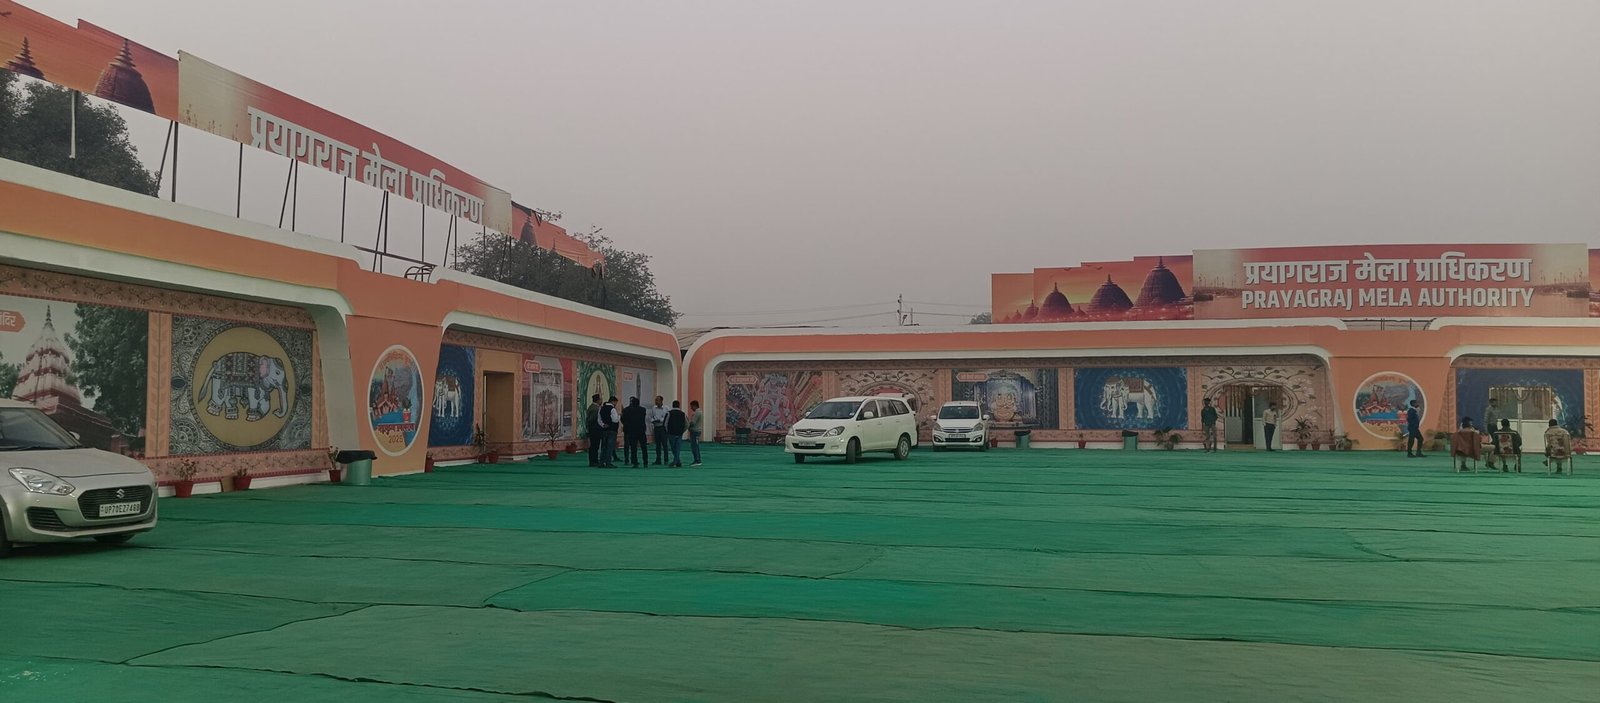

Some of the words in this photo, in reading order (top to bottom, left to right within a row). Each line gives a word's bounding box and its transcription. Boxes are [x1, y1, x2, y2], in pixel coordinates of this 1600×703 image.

[247, 106, 360, 181] प्रयागराज
[361, 142, 409, 198] मेला
[410, 168, 485, 226] प्राधिकरण
[1242, 260, 1350, 285] प्रयागराज
[1352, 252, 1410, 283] मेला
[1413, 251, 1533, 282] प्राधिकरण
[1241, 288, 1353, 311] PRAYAGRAJ
[1359, 288, 1412, 308] MELA
[1417, 287, 1535, 307] AUTHORITY
[388, 435, 404, 444] 2025
